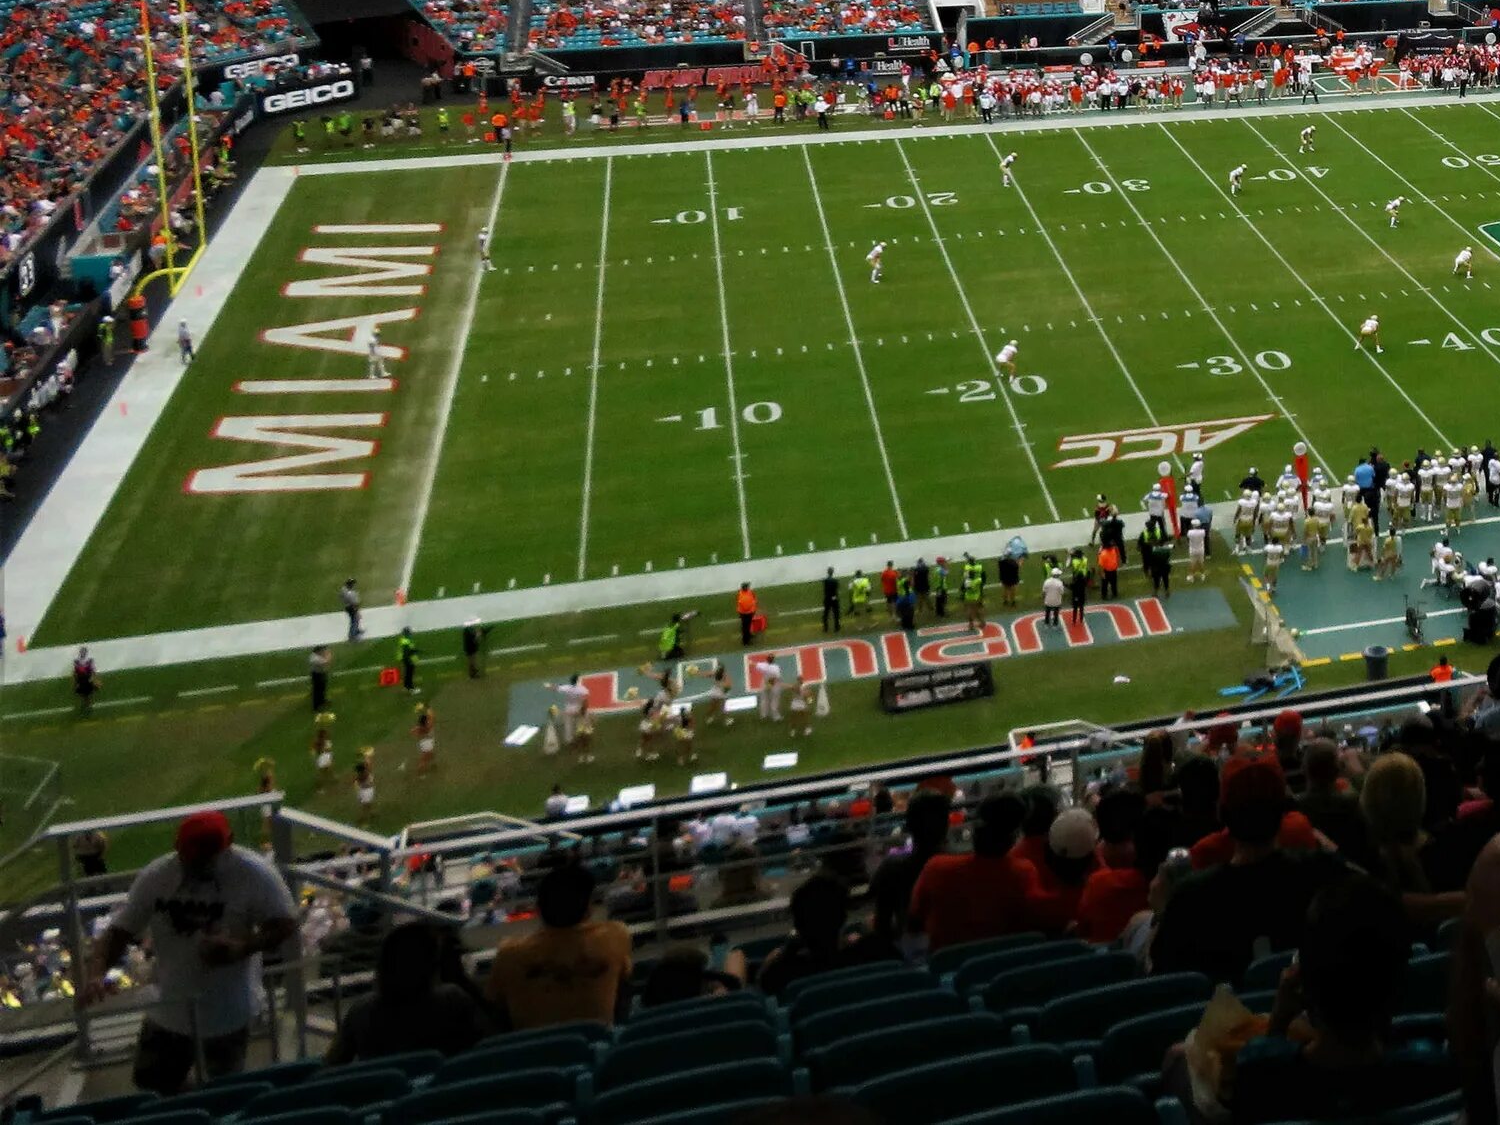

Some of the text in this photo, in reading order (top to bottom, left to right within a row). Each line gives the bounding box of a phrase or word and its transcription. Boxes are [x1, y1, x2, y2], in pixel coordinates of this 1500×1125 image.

[264, 80, 354, 114] GEICO
[1084, 178, 1150, 196] 30
[1267, 164, 1329, 182] 40
[674, 205, 745, 224] 10
[887, 191, 958, 210] 20
[182, 222, 448, 495] MIAMI
[1205, 349, 1293, 376] 30
[955, 373, 1048, 405] 20
[694, 400, 783, 432] 10
[1051, 414, 1275, 470] ACC
